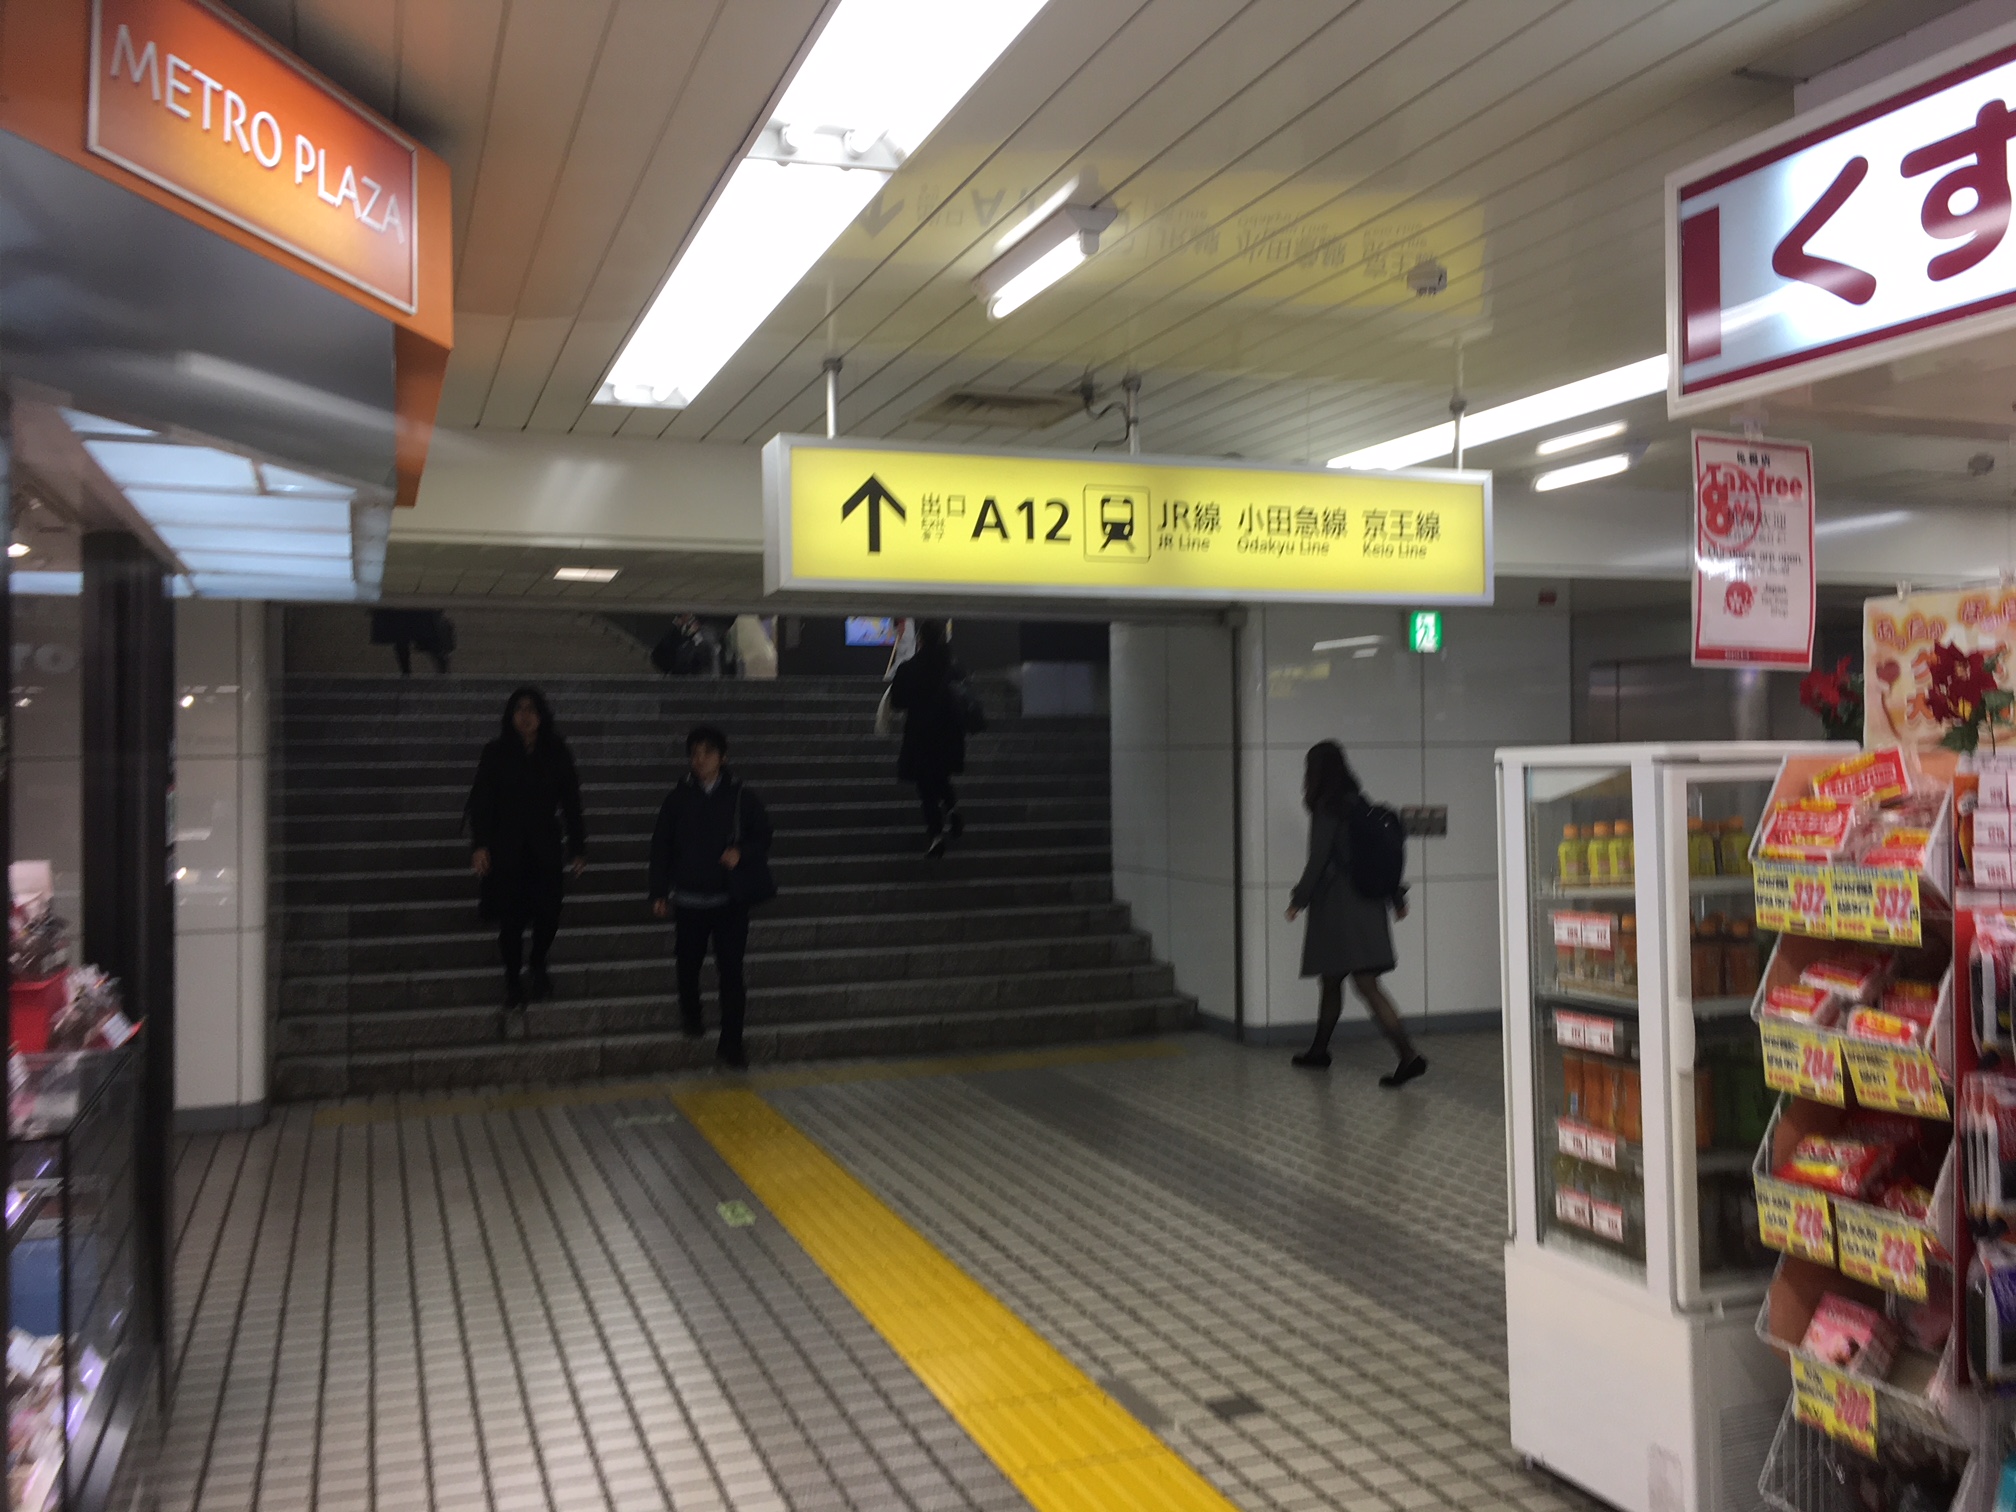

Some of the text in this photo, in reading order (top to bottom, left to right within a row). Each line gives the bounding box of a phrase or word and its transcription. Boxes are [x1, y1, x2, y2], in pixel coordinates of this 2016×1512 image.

[110, 23, 406, 245] METRO PLAZA
[970, 494, 1073, 546] A12
[1157, 499, 1441, 542] JR線 小田急線 京王線
[1179, 534, 1211, 553] Line
[1237, 536, 1330, 558] Odakyu Line
[1361, 540, 1427, 560] Keio Line
